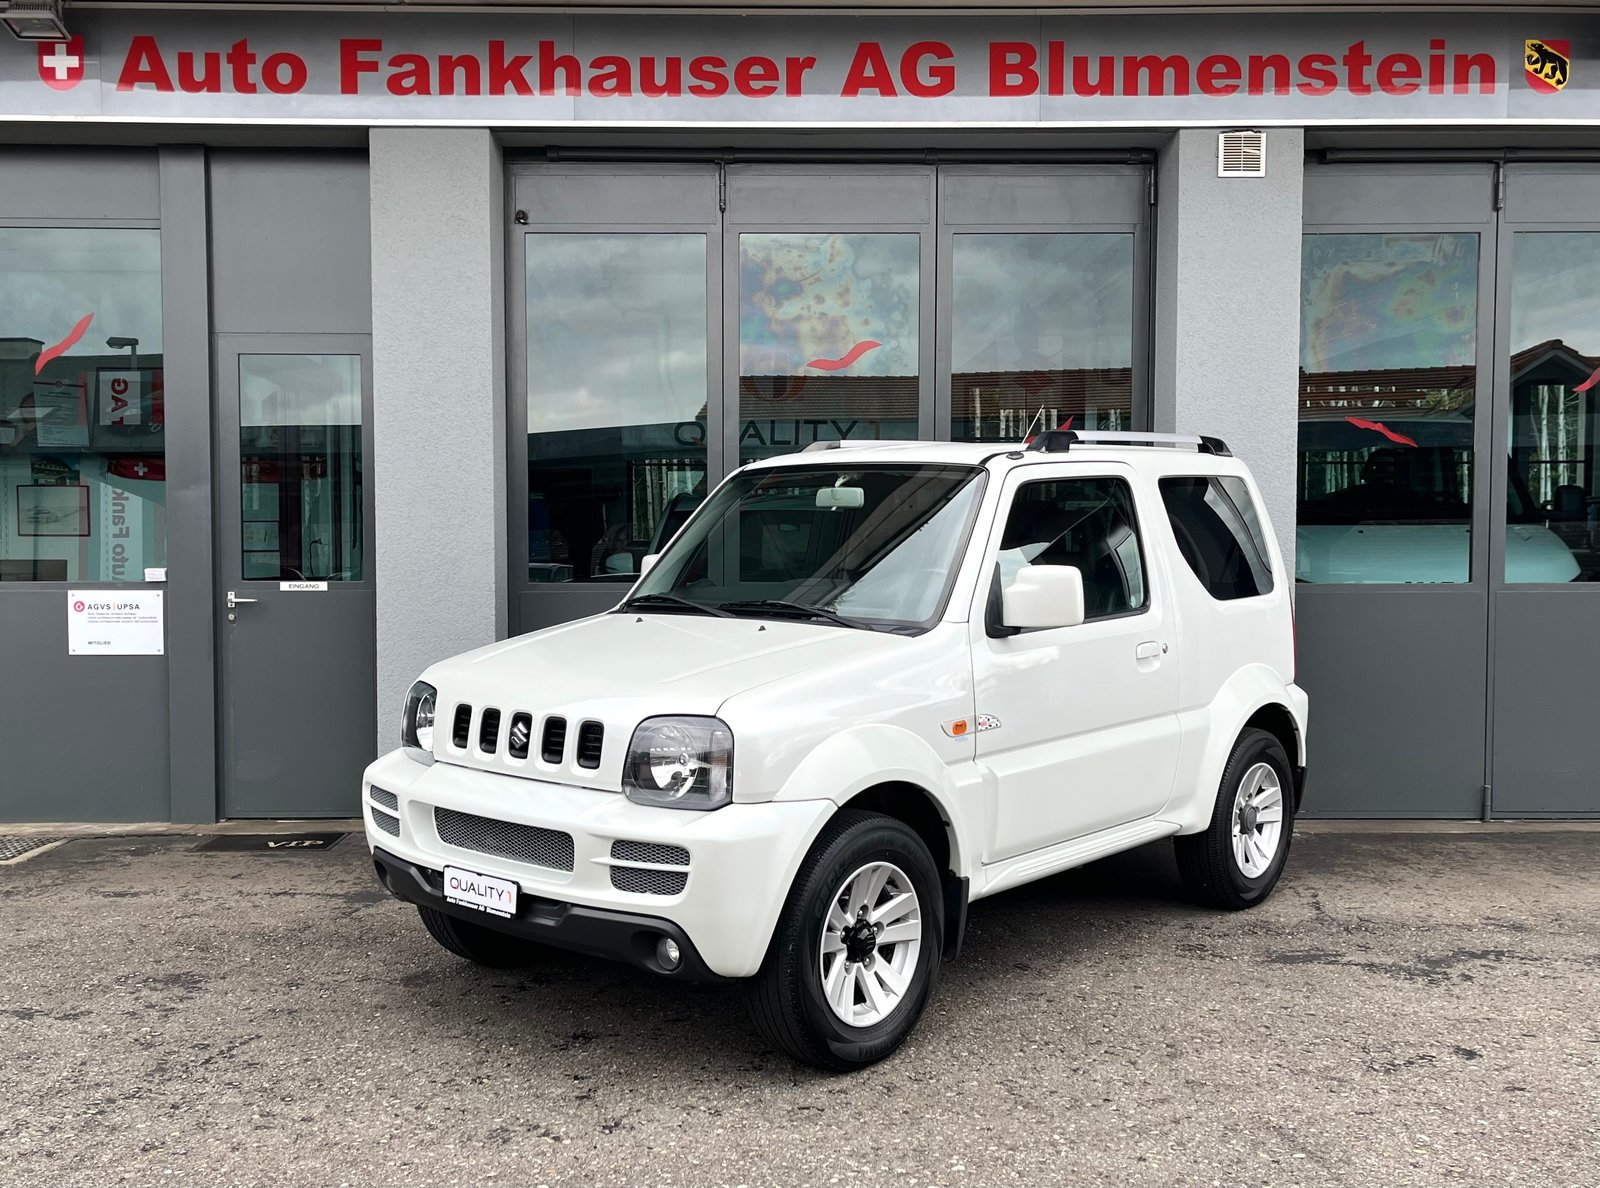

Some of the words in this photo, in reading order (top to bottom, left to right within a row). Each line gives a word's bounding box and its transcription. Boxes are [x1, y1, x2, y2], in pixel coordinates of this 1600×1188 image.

[116, 36, 307, 95] Auto
[340, 39, 815, 98] Fankhauser
[841, 41, 956, 98] AG
[989, 39, 1496, 97] Blumenstein
[674, 419, 858, 446] QALITY
[267, 840, 324, 848] VIP
[450, 877, 504, 901] QUALITY
